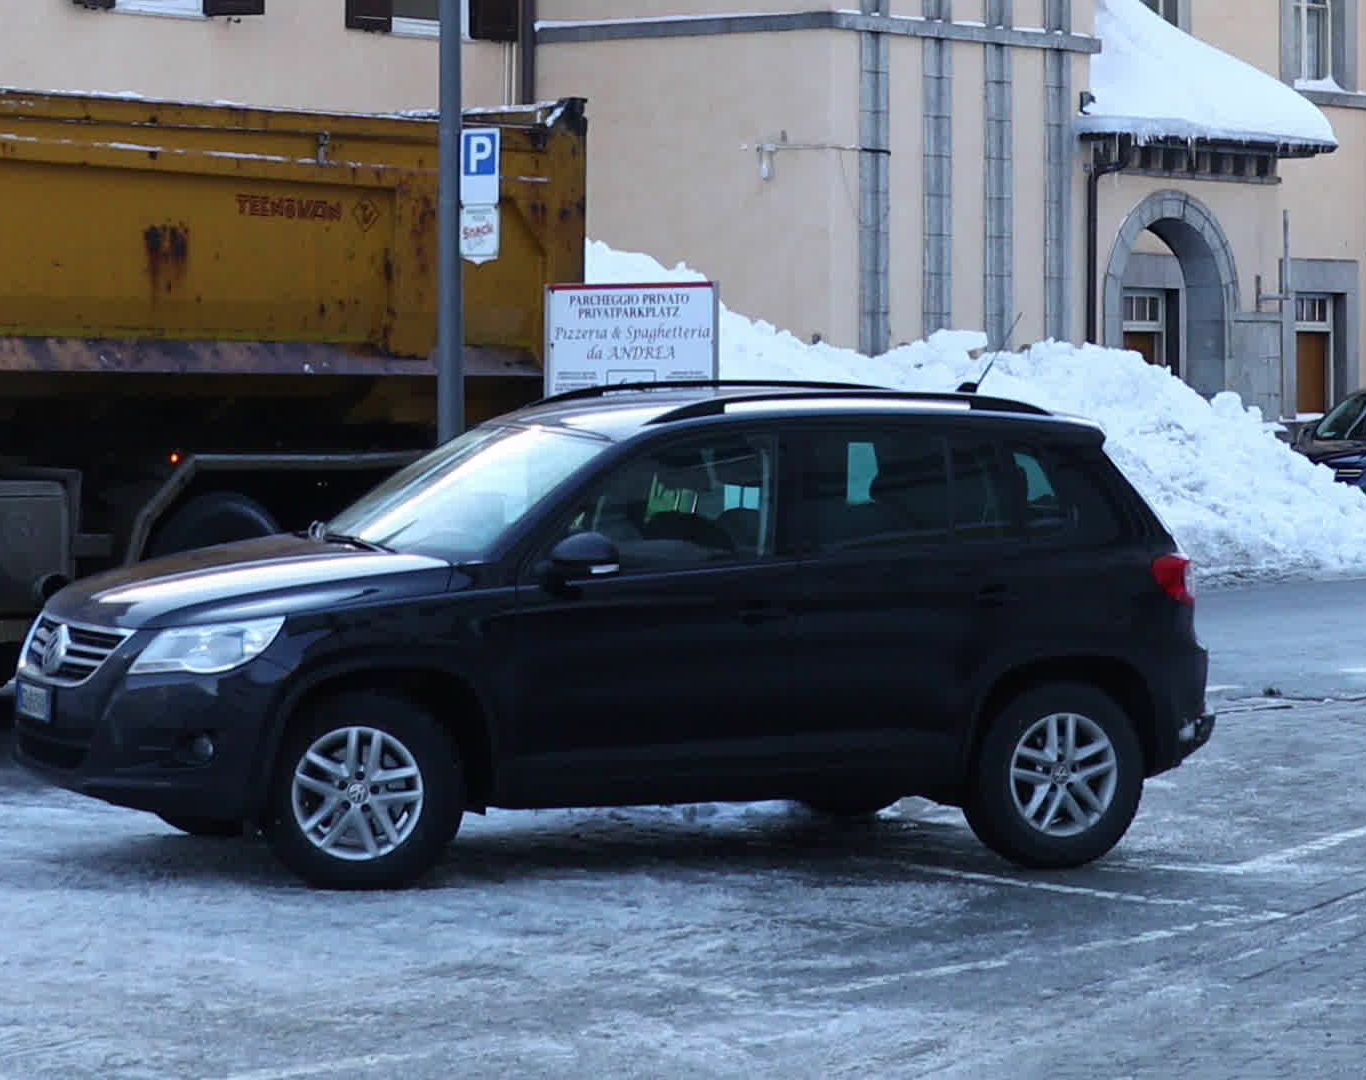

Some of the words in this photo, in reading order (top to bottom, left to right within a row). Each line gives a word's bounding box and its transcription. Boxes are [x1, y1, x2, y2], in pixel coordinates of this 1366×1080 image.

[470, 136, 492, 173] P
[569, 294, 639, 306] PARCHEGGIO
[642, 293, 690, 305] PRIVATO
[578, 307, 680, 319] PRIVATPARKPLATZ
[555, 326, 607, 341] Pizzeria
[611, 325, 622, 339] &
[626, 323, 711, 344] Spaghetteria
[586, 344, 603, 360] da
[608, 345, 676, 361] ANDREA
